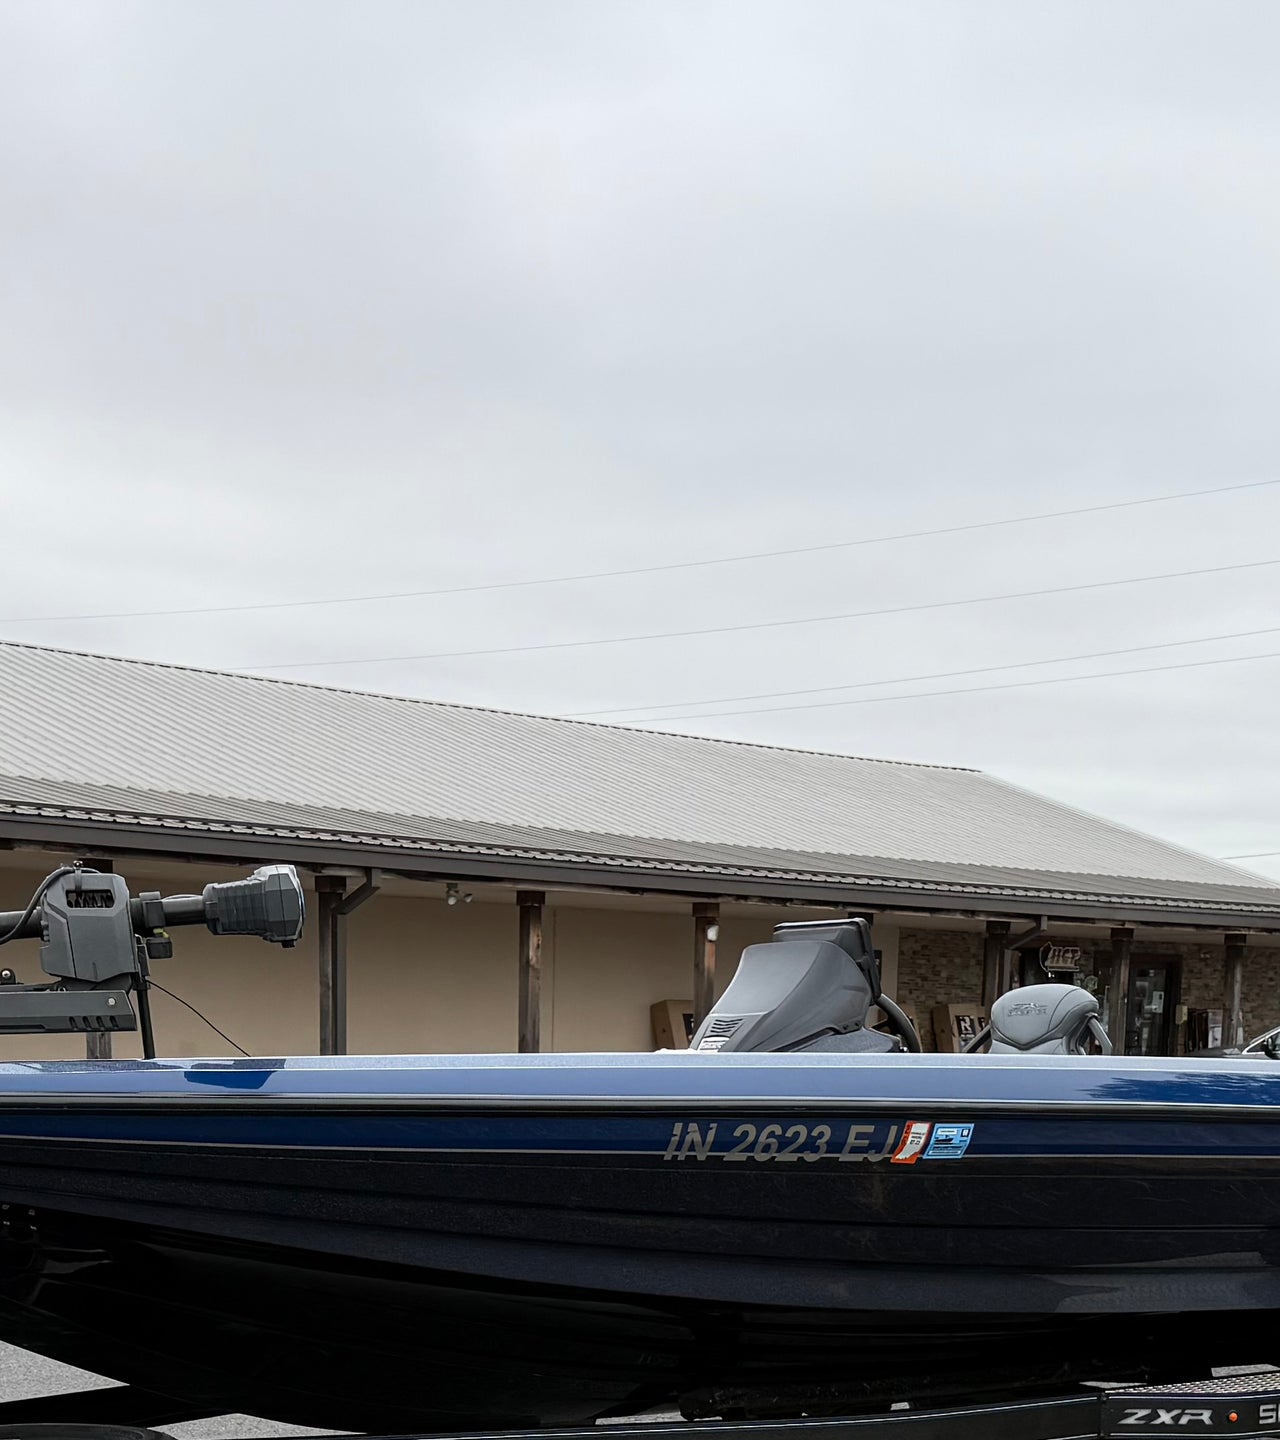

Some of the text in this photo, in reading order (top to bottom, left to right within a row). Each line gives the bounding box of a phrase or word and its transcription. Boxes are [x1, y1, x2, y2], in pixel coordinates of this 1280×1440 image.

[663, 1122, 718, 1162] IN
[723, 1123, 832, 1162] 2623
[838, 1124, 899, 1162] EJ
[1117, 1408, 1214, 1425] ZXR
